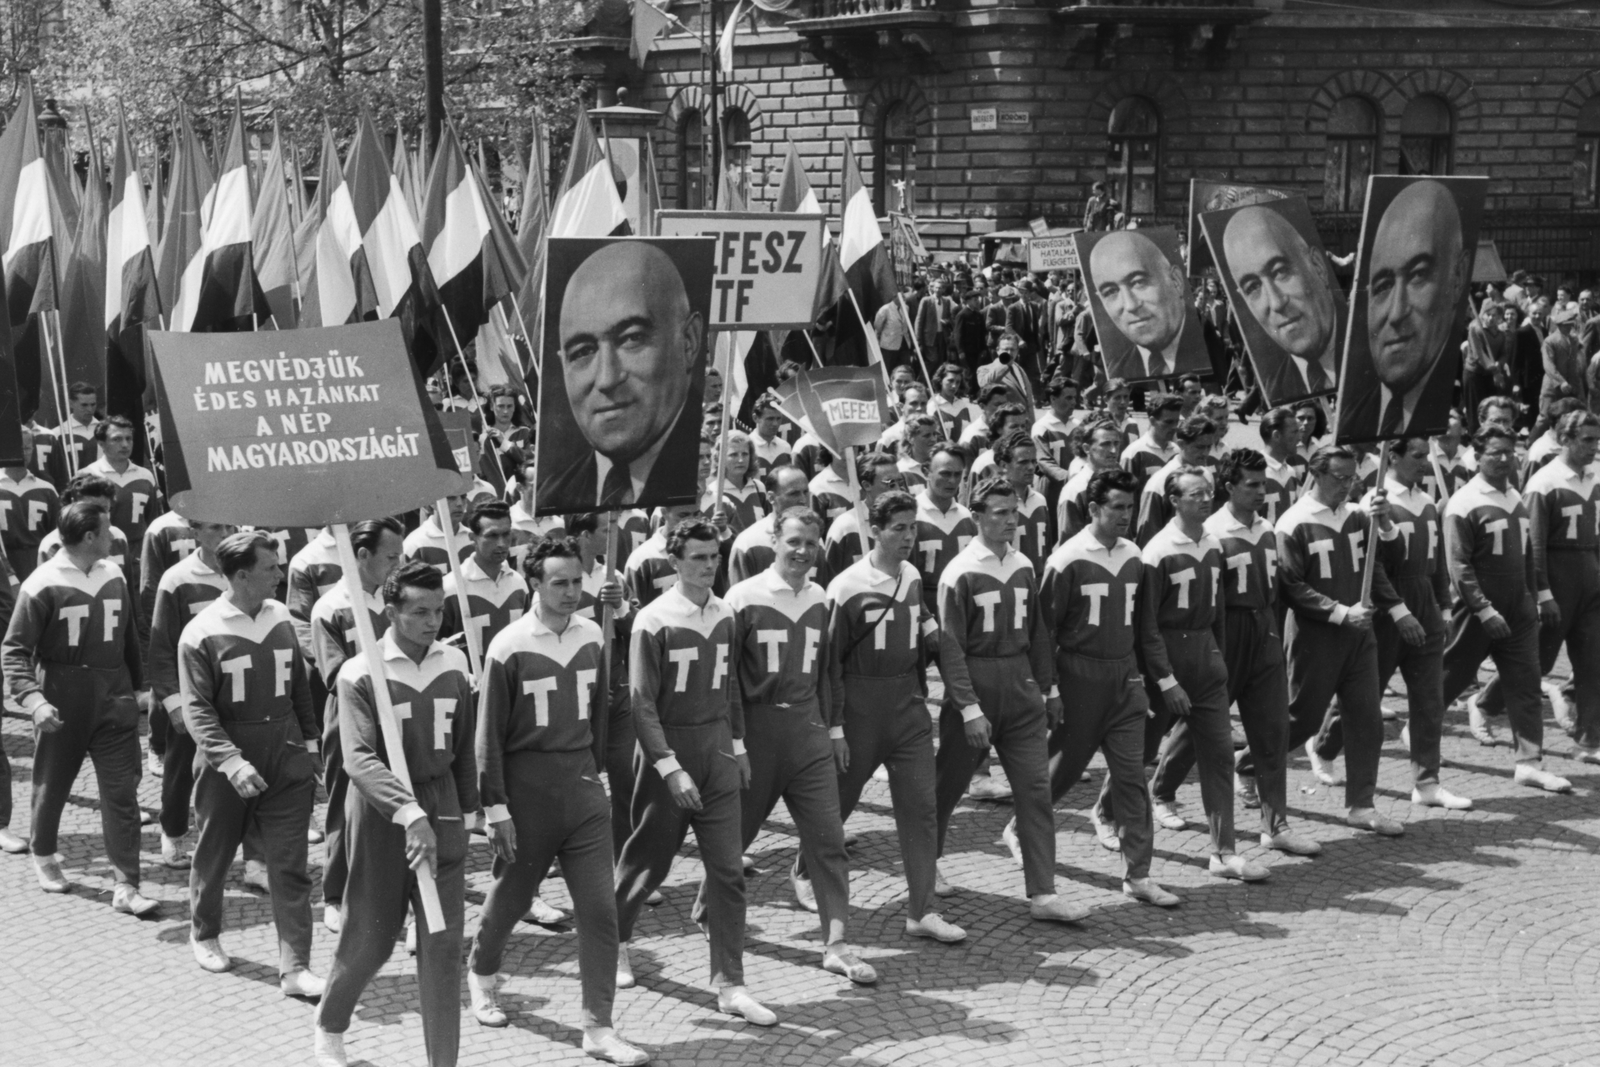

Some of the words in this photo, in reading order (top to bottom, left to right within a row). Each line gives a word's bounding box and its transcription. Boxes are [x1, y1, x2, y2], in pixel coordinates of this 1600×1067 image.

[715, 280, 754, 323] TF
[204, 350, 364, 385] MEGVÉDJÜK
[193, 386, 258, 412] ÉDES
[265, 380, 380, 408] HAZÁNKAT
[828, 401, 879, 421] MEFESZ
[256, 416, 273, 437] A
[280, 406, 332, 435] NÉP
[206, 426, 420, 473] MAGYARORSZÁGÁT
